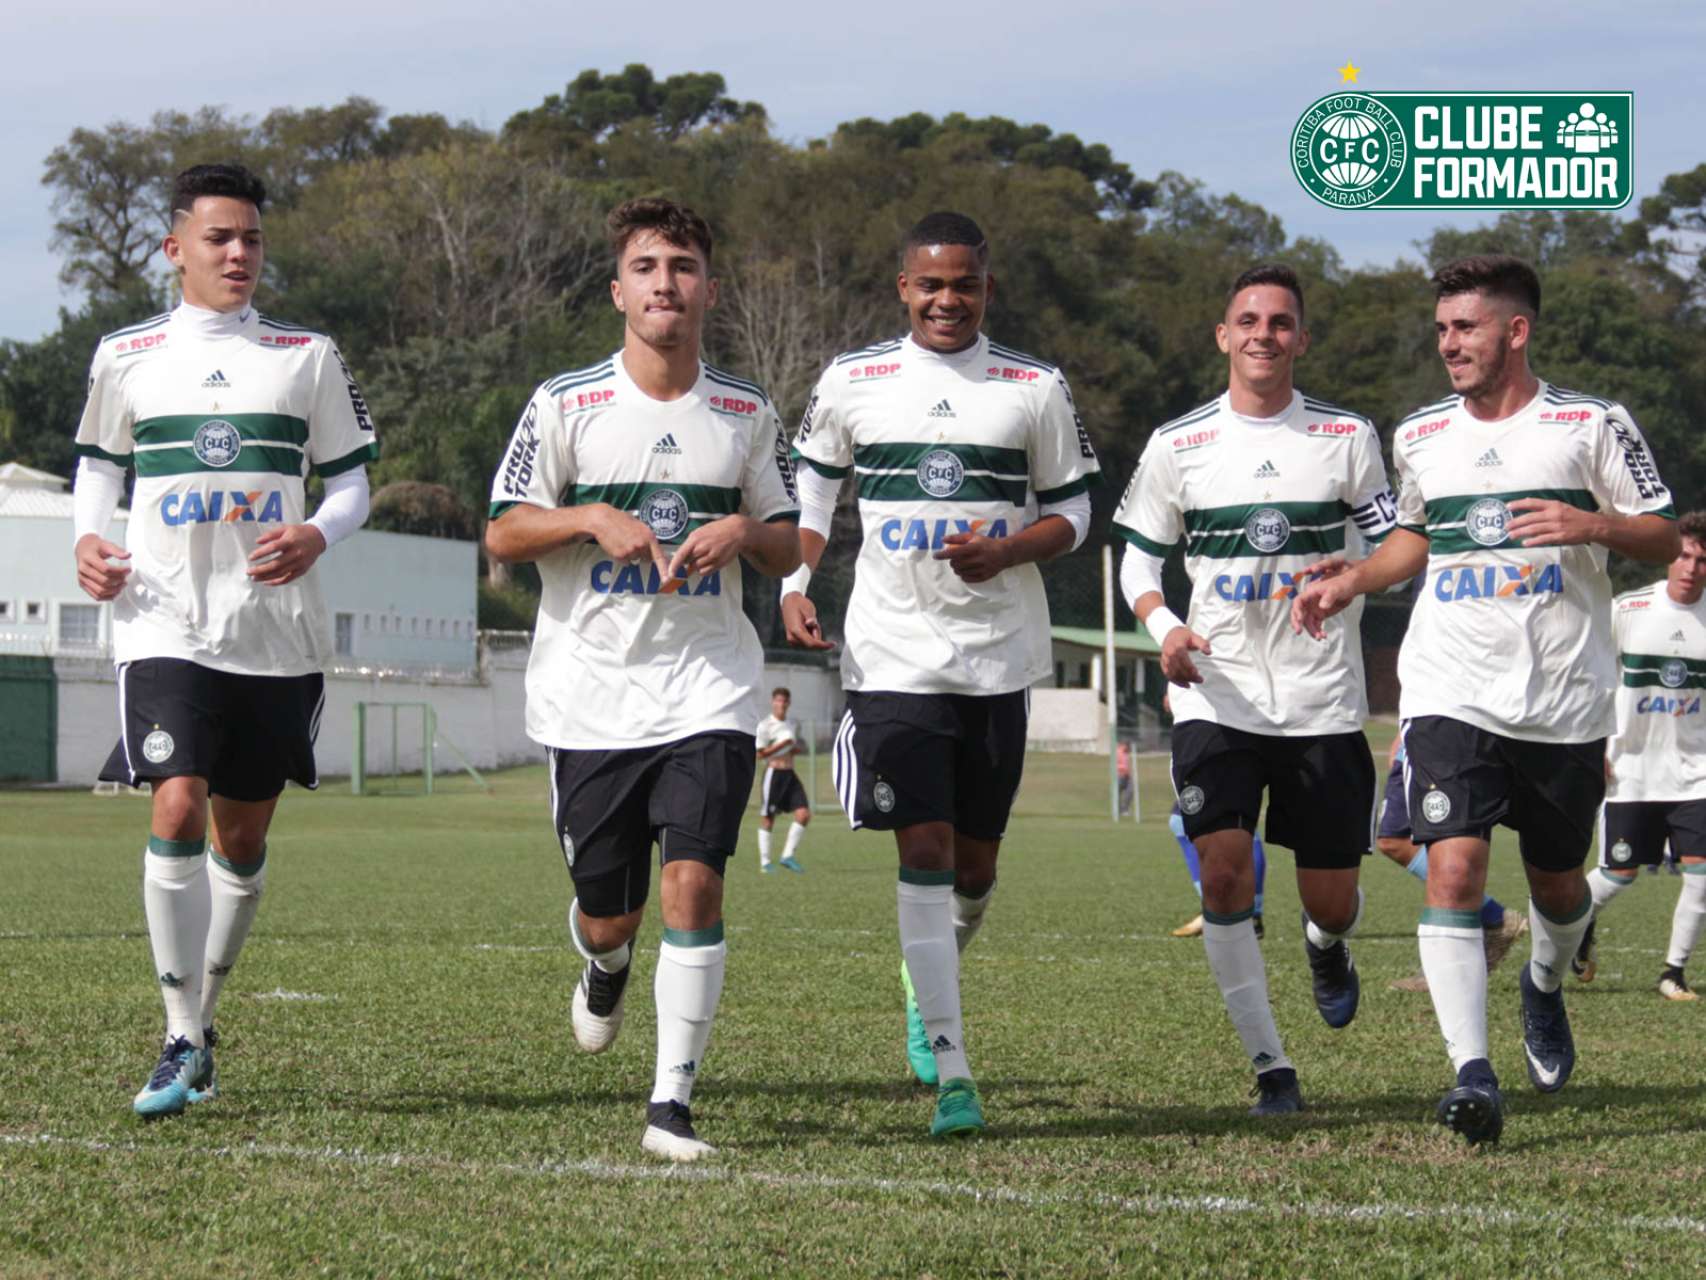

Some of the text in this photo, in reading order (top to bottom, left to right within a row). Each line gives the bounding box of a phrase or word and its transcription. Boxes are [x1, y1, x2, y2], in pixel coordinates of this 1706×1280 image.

[130, 333, 167, 350] RDP
[275, 336, 312, 347] RDP
[864, 363, 902, 377] RDP
[1001, 368, 1040, 382] RDP
[577, 390, 615, 408] RDP
[722, 398, 757, 415] RDP
[1555, 411, 1592, 422] RDP
[1322, 424, 1357, 434] RDP
[1417, 418, 1450, 438] RDP
[515, 432, 541, 498] TORK
[1632, 440, 1666, 498] TORK
[1625, 453, 1653, 499] PRO
[160, 490, 282, 526] CAIXA
[1215, 571, 1323, 600] CAIX
[1435, 564, 1564, 602] CAIXA
[1637, 696, 1700, 717] CAIXA
